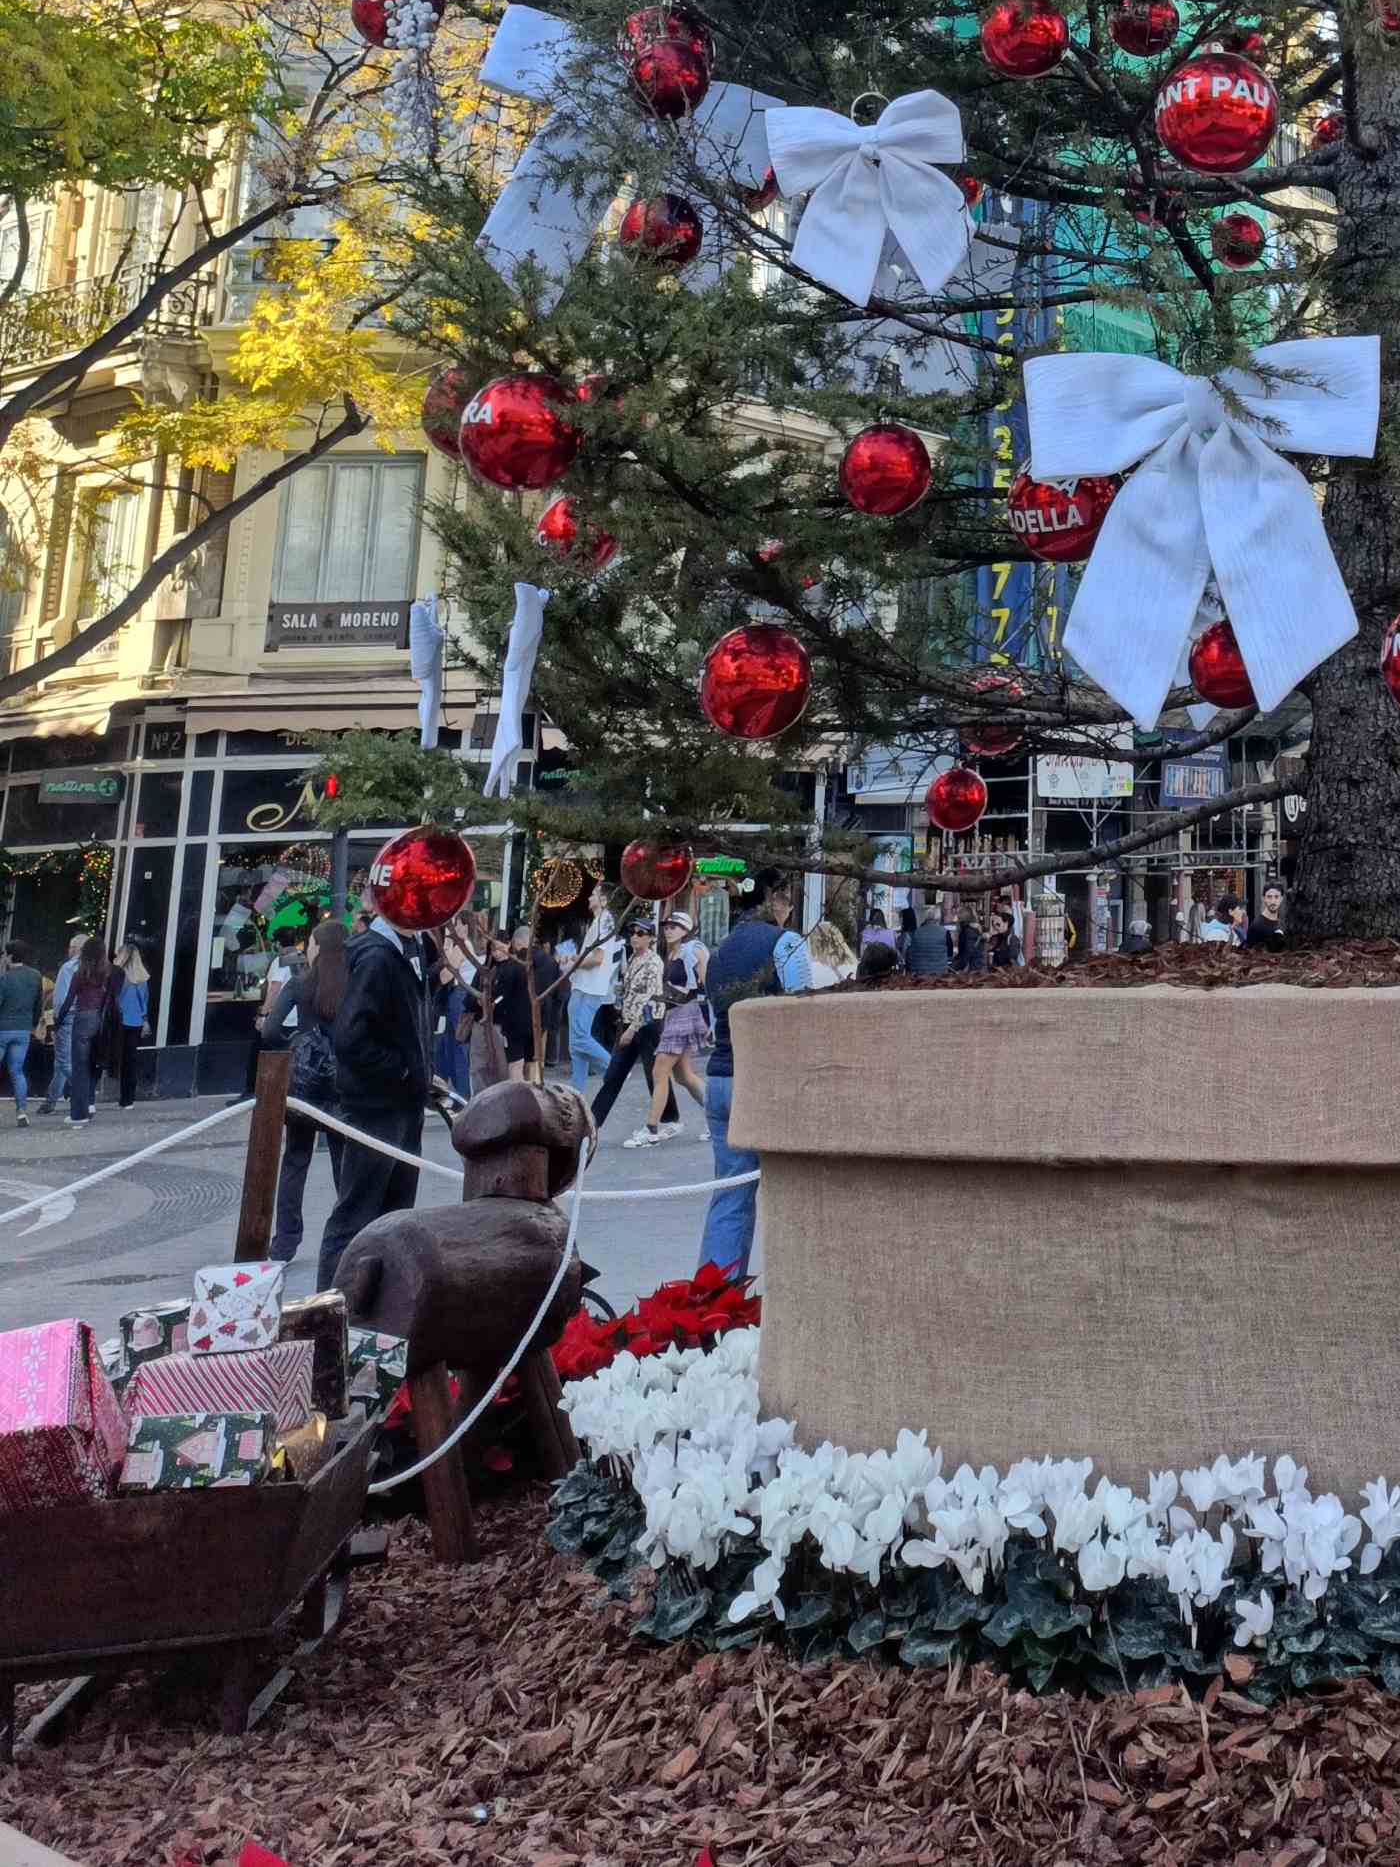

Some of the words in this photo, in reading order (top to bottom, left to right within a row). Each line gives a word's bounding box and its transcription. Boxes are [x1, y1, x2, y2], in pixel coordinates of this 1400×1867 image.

[1155, 77, 1202, 120] ANT
[1211, 75, 1270, 107] PAU
[281, 613, 318, 629] SALA
[339, 612, 400, 628] MORENO
[171, 733, 182, 750] 2
